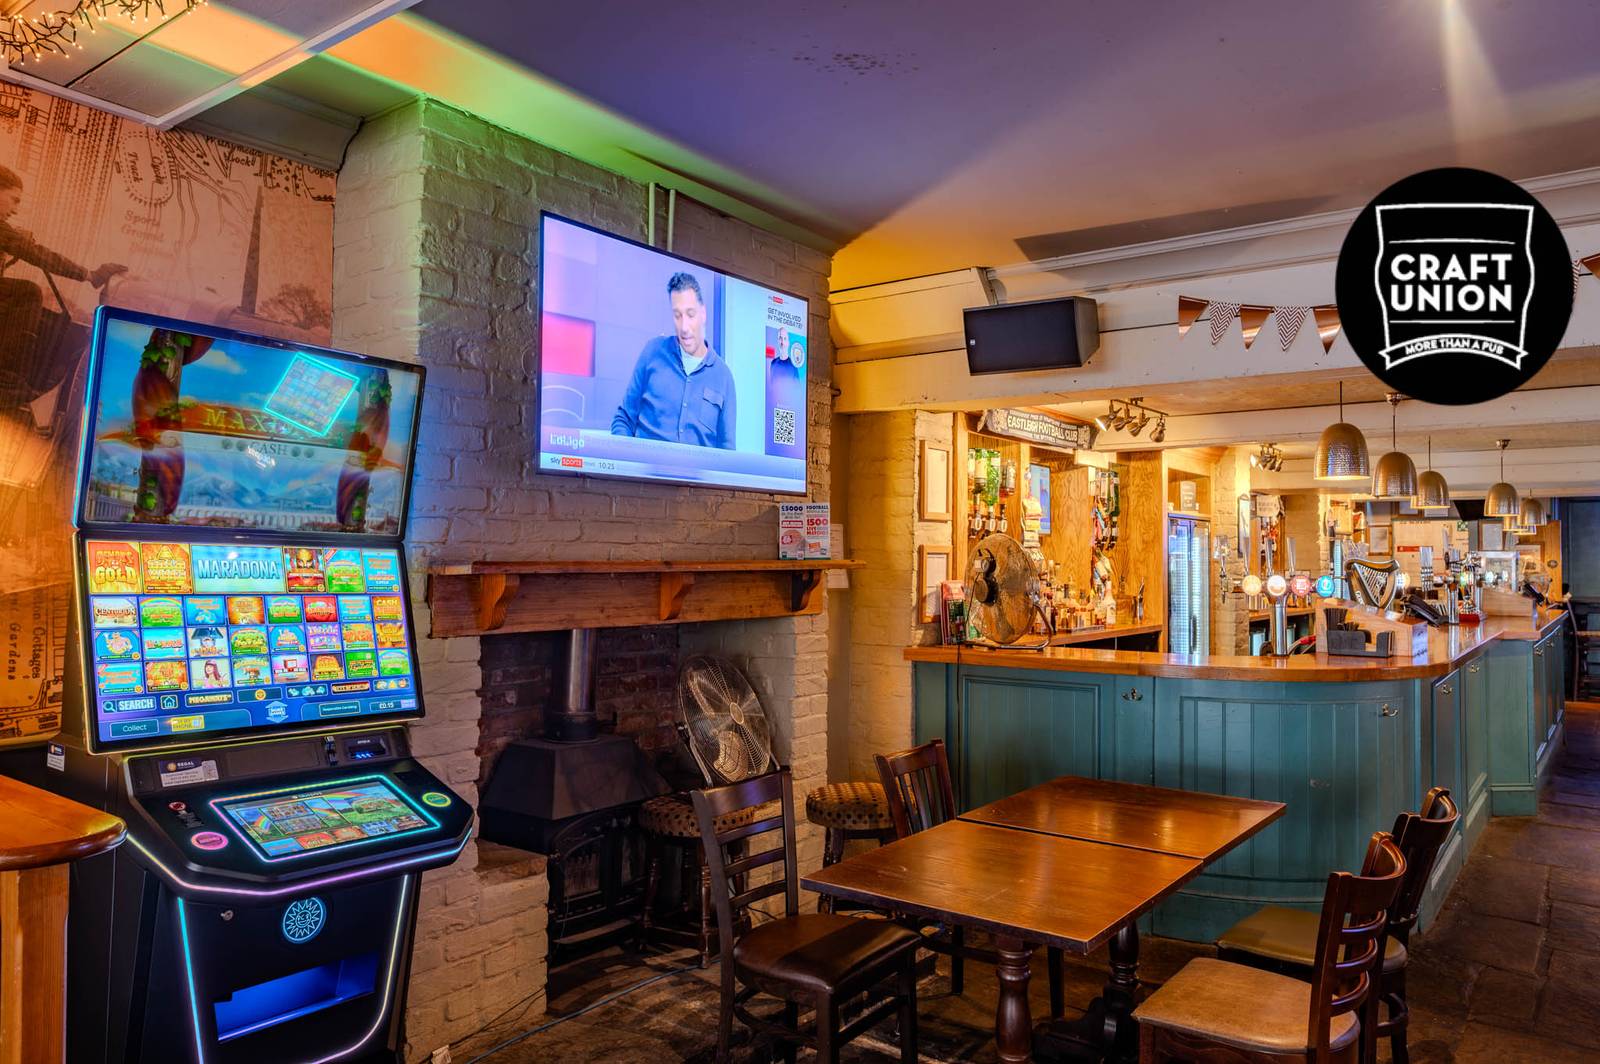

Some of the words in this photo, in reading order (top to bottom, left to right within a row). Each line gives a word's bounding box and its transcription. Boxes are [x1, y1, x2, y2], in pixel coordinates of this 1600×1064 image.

[128, 152, 143, 182] Track
[774, 315, 783, 323] THE
[778, 311, 802, 322] INVOLVED
[1007, 415, 1039, 433] EASTLEIGH
[1039, 421, 1065, 439] FOOTBALL
[1065, 429, 1078, 442] CLUB
[250, 441, 288, 456] CASH
[550, 457, 560, 465] sky
[562, 457, 582, 467] sports
[95, 566, 137, 585] GOLD
[197, 560, 280, 580] MARADONA
[8, 622, 21, 681] Gardens
[29, 626, 46, 680] Cottages
[117, 698, 154, 711] SEARCH
[122, 723, 147, 732] Collect
